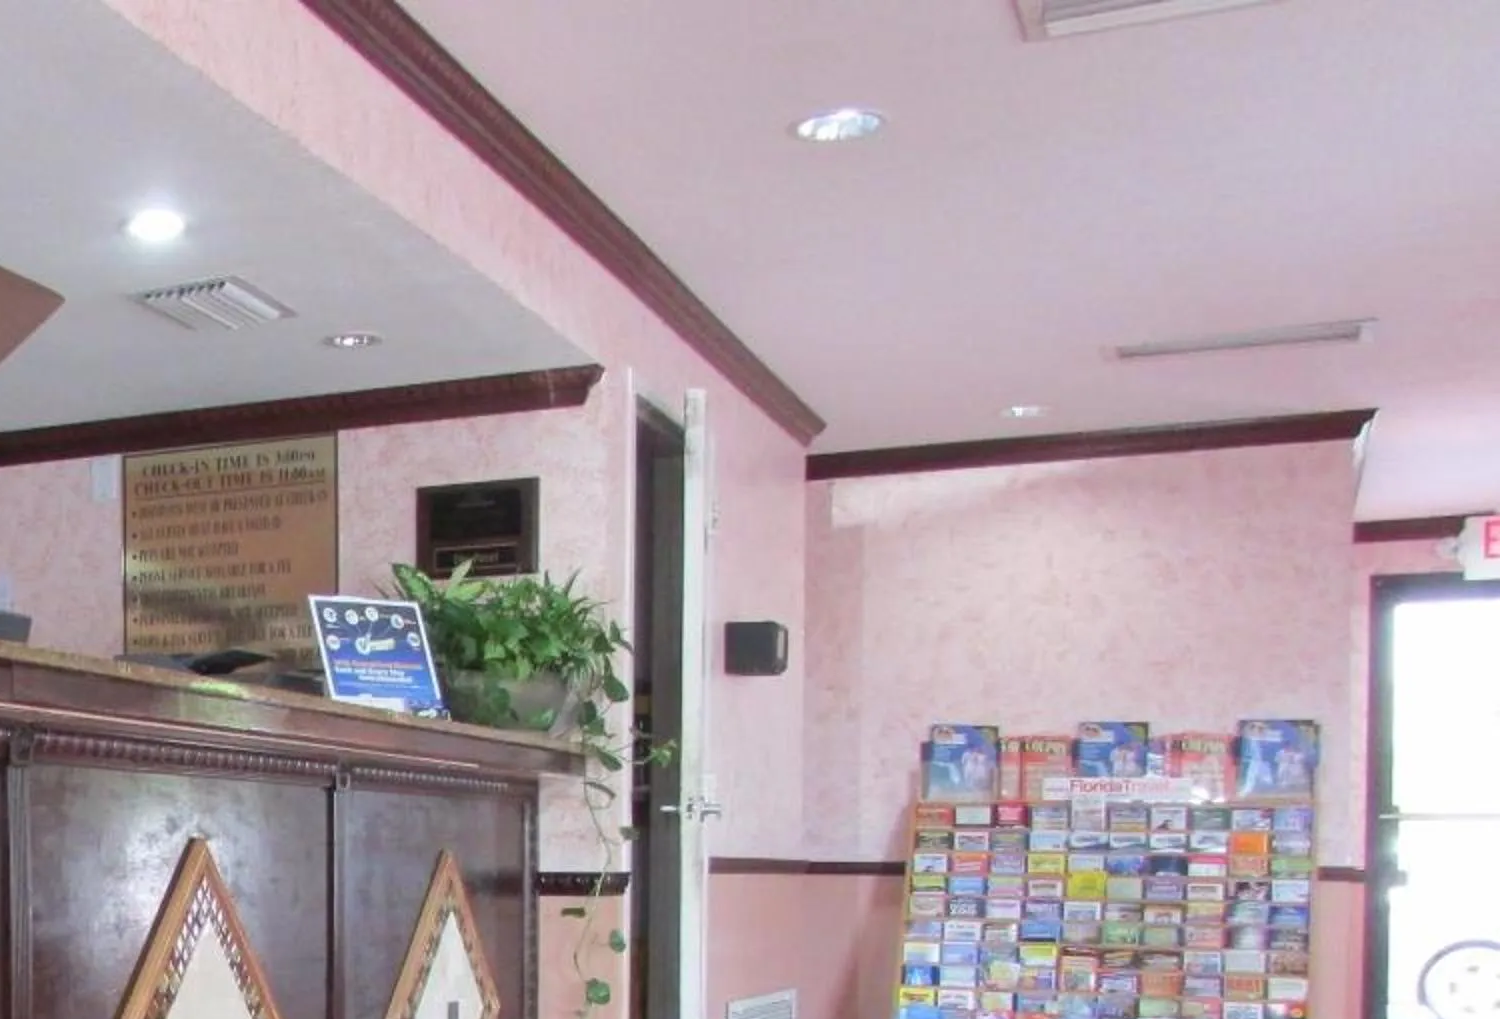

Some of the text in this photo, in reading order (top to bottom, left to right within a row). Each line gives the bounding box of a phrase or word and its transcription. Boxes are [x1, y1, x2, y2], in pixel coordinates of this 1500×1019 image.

[142, 458, 209, 477] CHECK-IN
[217, 454, 249, 473] TIME
[256, 453, 270, 468] IS
[134, 475, 213, 497] CHECK-OUT
[220, 472, 252, 489] TIME
[259, 469, 273, 484] IS
